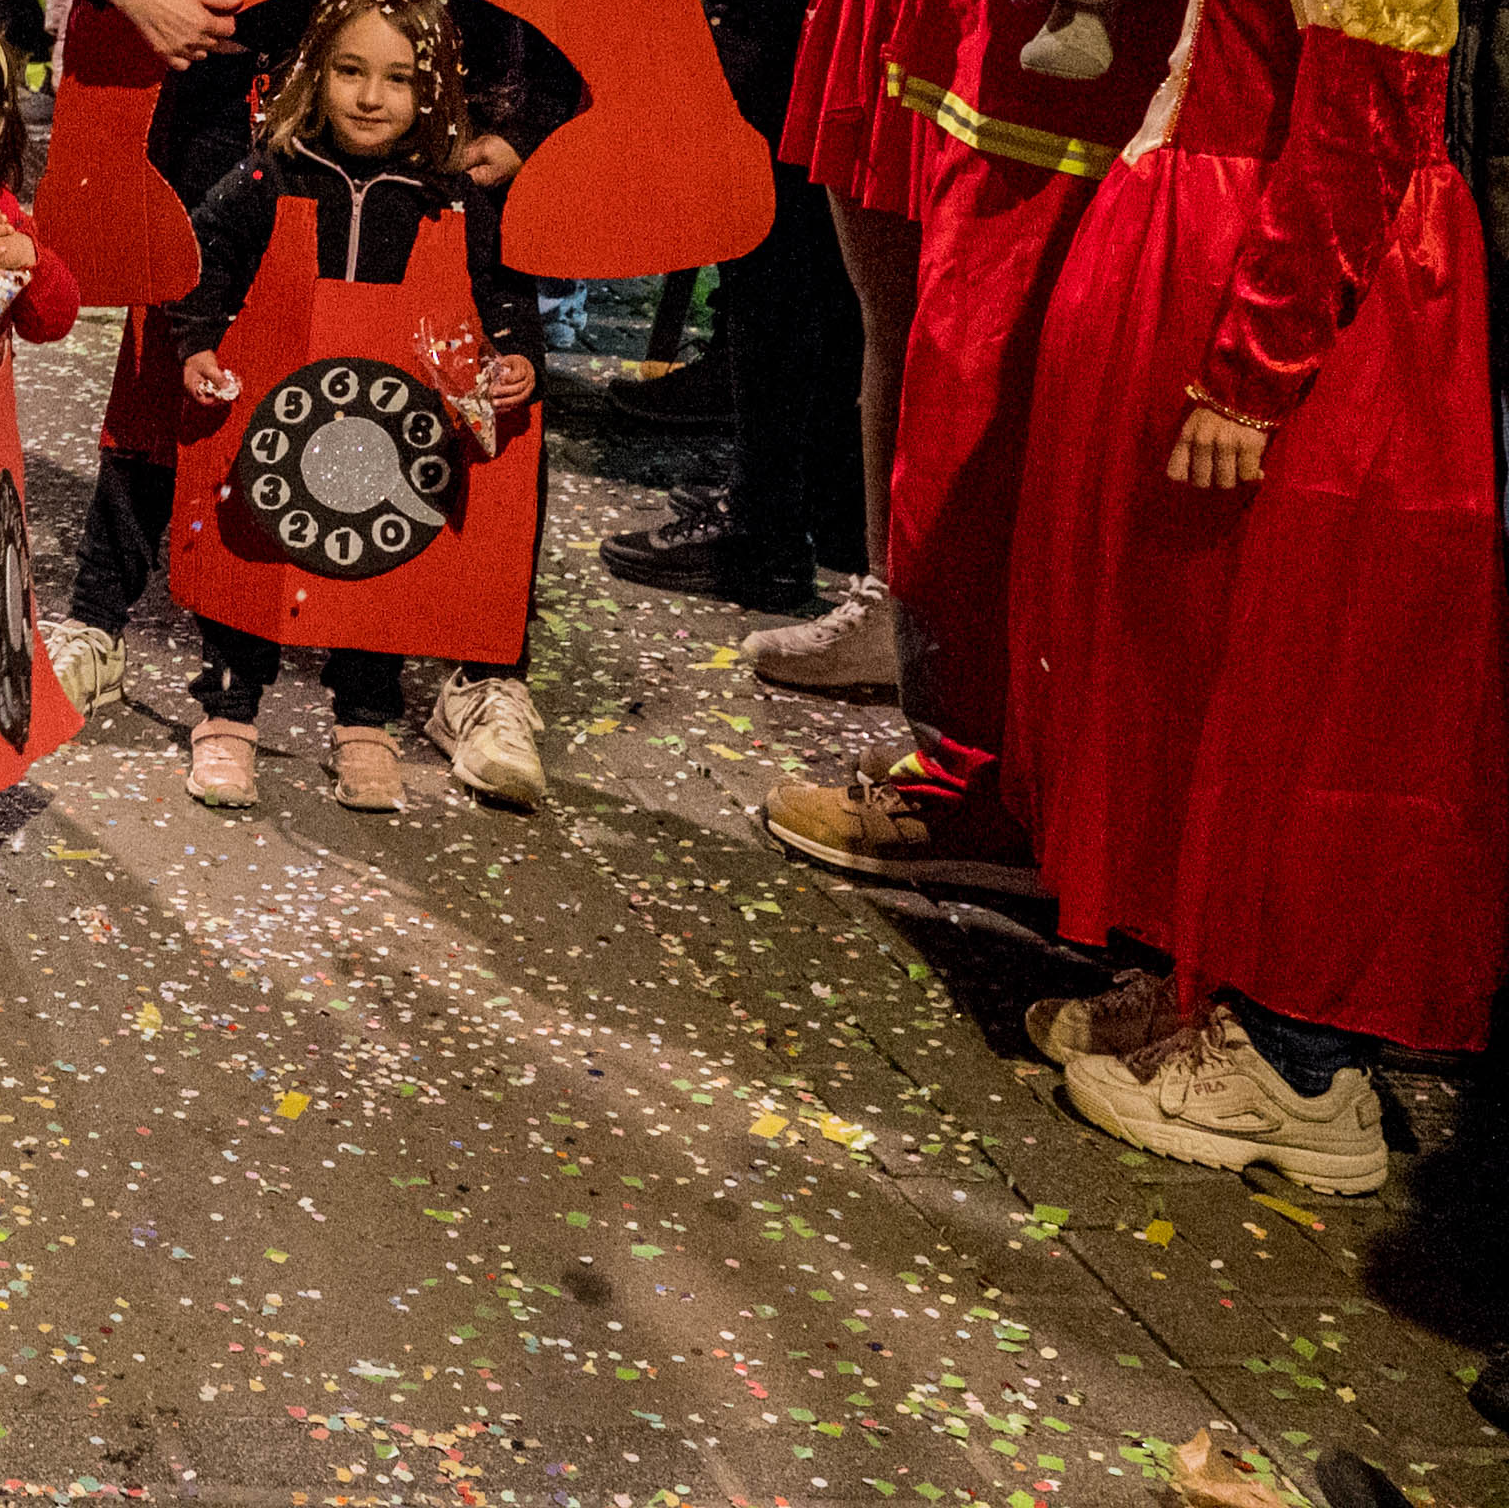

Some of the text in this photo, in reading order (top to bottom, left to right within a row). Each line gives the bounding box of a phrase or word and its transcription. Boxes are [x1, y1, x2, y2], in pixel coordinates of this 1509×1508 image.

[327, 370, 351, 399] 6
[375, 381, 403, 410] 7
[284, 390, 304, 420] 5
[411, 412, 434, 447] 8
[255, 431, 281, 460] 4
[420, 459, 444, 490] 9
[260, 477, 282, 507] 3
[288, 512, 309, 542] 2
[380, 520, 400, 546] 0
[335, 531, 350, 560] 1
